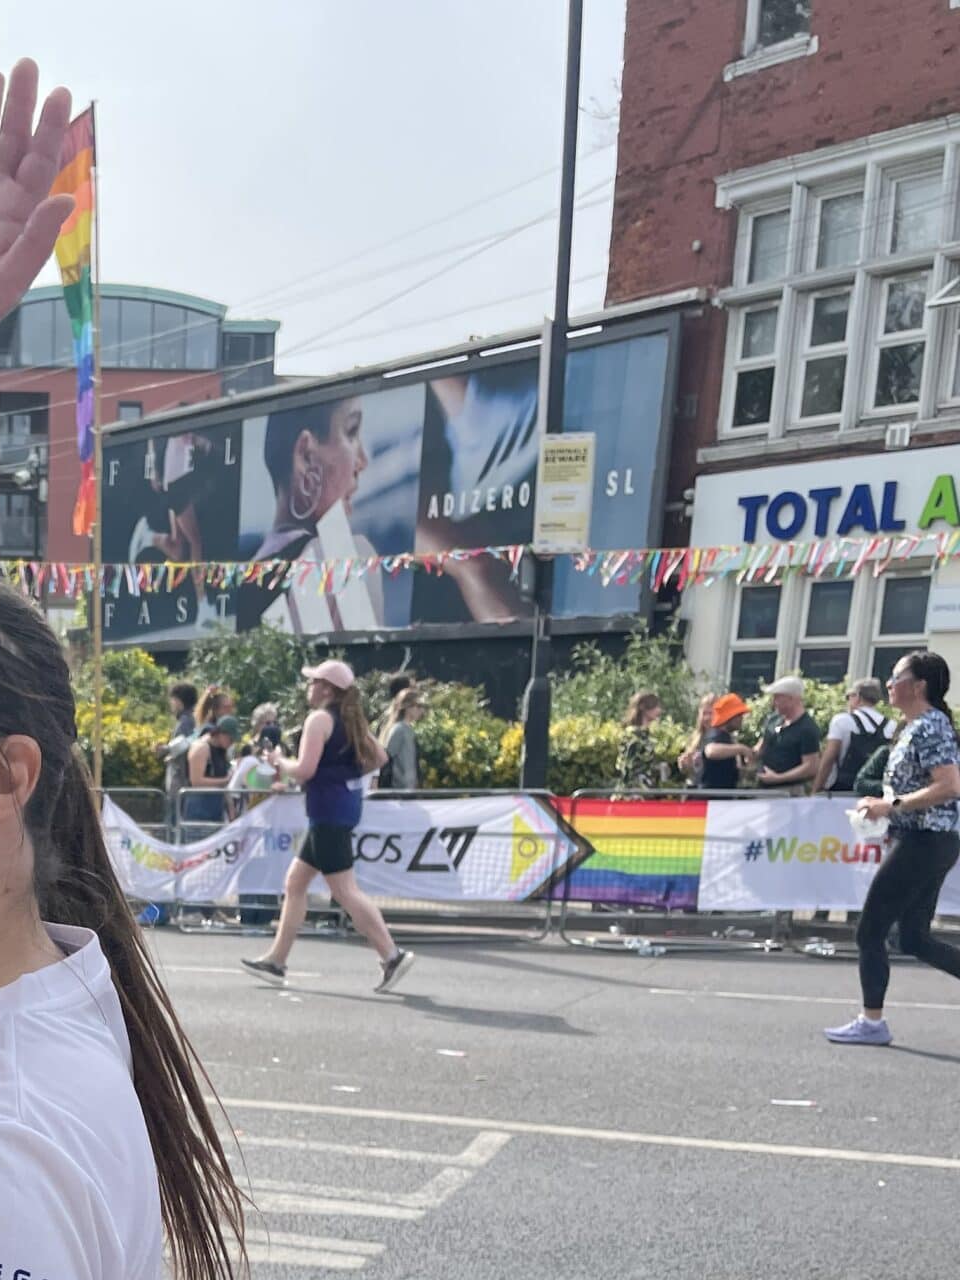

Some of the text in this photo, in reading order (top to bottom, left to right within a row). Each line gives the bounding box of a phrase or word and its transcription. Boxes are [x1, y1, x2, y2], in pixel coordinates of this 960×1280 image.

[108, 437, 236, 487] FEEL
[544, 455, 586, 463] BEWARE
[427, 481, 531, 519] ADIZERO
[605, 468, 635, 497] SL
[738, 480, 907, 545] TOTAL
[104, 593, 230, 628] FAST
